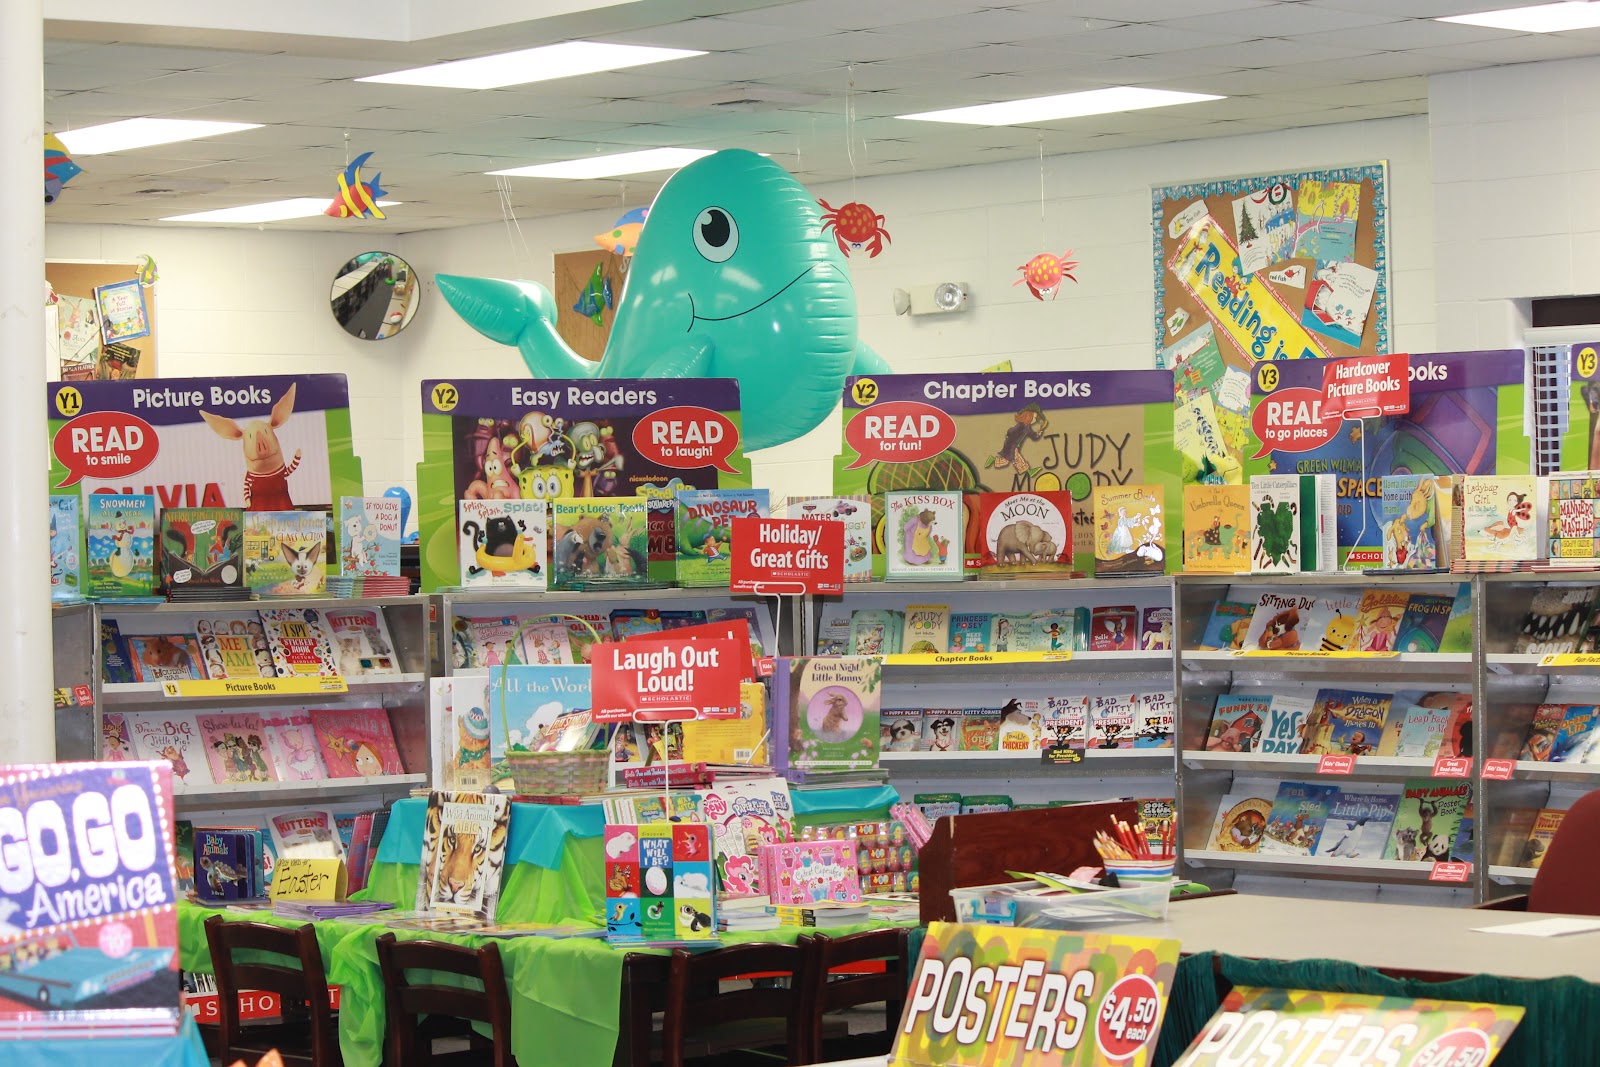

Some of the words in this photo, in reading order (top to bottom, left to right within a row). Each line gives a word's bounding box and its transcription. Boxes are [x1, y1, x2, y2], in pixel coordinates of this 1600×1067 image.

[1278, 274, 1286, 282] fish
[1195, 243, 1277, 359] Reading
[1581, 354, 1596, 370] Y3
[1261, 369, 1277, 385] Y3
[1336, 362, 1390, 380] Hardcover
[1408, 362, 1448, 382] ooks
[856, 384, 876, 399] Y2
[924, 380, 1017, 402] Chapter
[1024, 379, 1092, 398] Books
[1328, 382, 1364, 398] Picture
[1366, 376, 1400, 394] Books
[59, 393, 80, 410] Y1
[133, 388, 204, 409] Picture
[212, 386, 272, 406] Books
[435, 390, 456, 405] Y2
[511, 387, 561, 409] Easy
[568, 387, 657, 406] Readers
[652, 420, 724, 445] READ
[865, 415, 940, 439] READ
[1266, 428, 1275, 438] to
[1278, 428, 1291, 441] go
[1294, 426, 1328, 441] places
[71, 426, 144, 453] READ
[880, 440, 896, 450] for
[898, 440, 922, 451] fun!
[661, 447, 674, 456] to
[676, 445, 713, 460] laugh!
[1043, 432, 1131, 470] JUDY
[86, 454, 98, 466] to
[101, 453, 131, 465] smile
[1296, 458, 1328, 474] GREEN
[1331, 458, 1363, 472] WILMA
[1336, 477, 1383, 498] SPACE
[1383, 480, 1400, 489] llama
[1400, 479, 1417, 488] llama
[1466, 484, 1498, 495] Ladybug
[100, 498, 146, 508] SNOWMEN
[890, 502, 903, 512] The
[904, 494, 930, 507] KISS
[932, 496, 956, 509] BOX
[1384, 492, 1398, 501] home
[1399, 491, 1412, 501] with
[58, 499, 74, 511] Cat
[366, 502, 373, 510] IF
[373, 502, 384, 510] YOU
[384, 502, 398, 510] GIVE
[463, 502, 486, 512] Splish,
[478, 508, 504, 519] Splash,
[503, 502, 544, 514] Splat!
[556, 504, 585, 514] Bear's
[587, 504, 615, 514] Loose
[687, 500, 758, 519] DINOSAUR
[1190, 496, 1222, 512] Umbrella
[1222, 497, 1245, 511] Queen
[1384, 506, 1400, 514] mama
[1560, 499, 1594, 516] MANNERS
[802, 513, 832, 521] MATER
[1000, 504, 1050, 522] MOON
[380, 523, 398, 531] DONUT
[1560, 518, 1594, 537] MASH-UP
[759, 523, 822, 550] Holiday/
[750, 548, 792, 568] Great
[796, 550, 829, 570] Gifts
[330, 616, 374, 628] KITTENS
[916, 612, 942, 621] JUDY
[284, 624, 290, 637] I
[291, 624, 307, 637] SPY
[908, 620, 942, 630] MOODY
[284, 638, 314, 646] STICKER
[291, 645, 310, 653] BOOK
[225, 652, 254, 666] AM!
[613, 646, 676, 674] Laugh
[681, 646, 720, 668] Out
[935, 654, 966, 663] Chapter
[968, 654, 992, 662] Books
[152, 668, 188, 678] HOUDINI
[637, 669, 694, 692] Loud!
[812, 673, 833, 682] Little
[836, 673, 863, 684] Bunny
[166, 684, 177, 694] Y1
[226, 682, 252, 693] Picture
[253, 682, 276, 692] Books
[1049, 700, 1069, 708] BAD
[1096, 698, 1117, 708] BAD
[1143, 693, 1165, 704] BAD
[1352, 696, 1372, 705] When
[1056, 706, 1084, 715] KITTY
[1105, 704, 1132, 714] KITTY
[1344, 706, 1386, 722] DRAGON
[1094, 717, 1132, 726] PRESIDENT
[1562, 714, 1591, 730] Ocean
[1568, 724, 1586, 737] Life
[143, 734, 171, 748] Little
[174, 735, 190, 752] Pig!
[1002, 741, 1030, 750] CHICKENS
[1405, 788, 1429, 798] BABY
[1430, 786, 1468, 798] ANIMALS
[704, 801, 727, 816] PONY
[1298, 800, 1322, 812] Sled
[1333, 802, 1366, 816] Little
[1368, 804, 1394, 820] Pip?
[1438, 800, 1462, 810] Poster
[1440, 807, 1457, 816] Book
[445, 806, 464, 820] Wild
[464, 808, 492, 821] Animals
[72, 783, 157, 879] GO
[278, 817, 326, 833] KITTENS
[206, 834, 224, 848] Baby
[642, 840, 670, 850] WHAT
[202, 844, 230, 856] Animals
[646, 848, 666, 858] WILL
[644, 857, 648, 866] I
[652, 856, 668, 867] BE?
[276, 864, 330, 896] Easter
[26, 872, 166, 929] America
[904, 956, 1095, 1052] POSTERS
[1102, 992, 1157, 1040] $4.50
[1126, 1027, 1147, 1042] each
[1181, 1009, 1418, 1067] POSTERS
